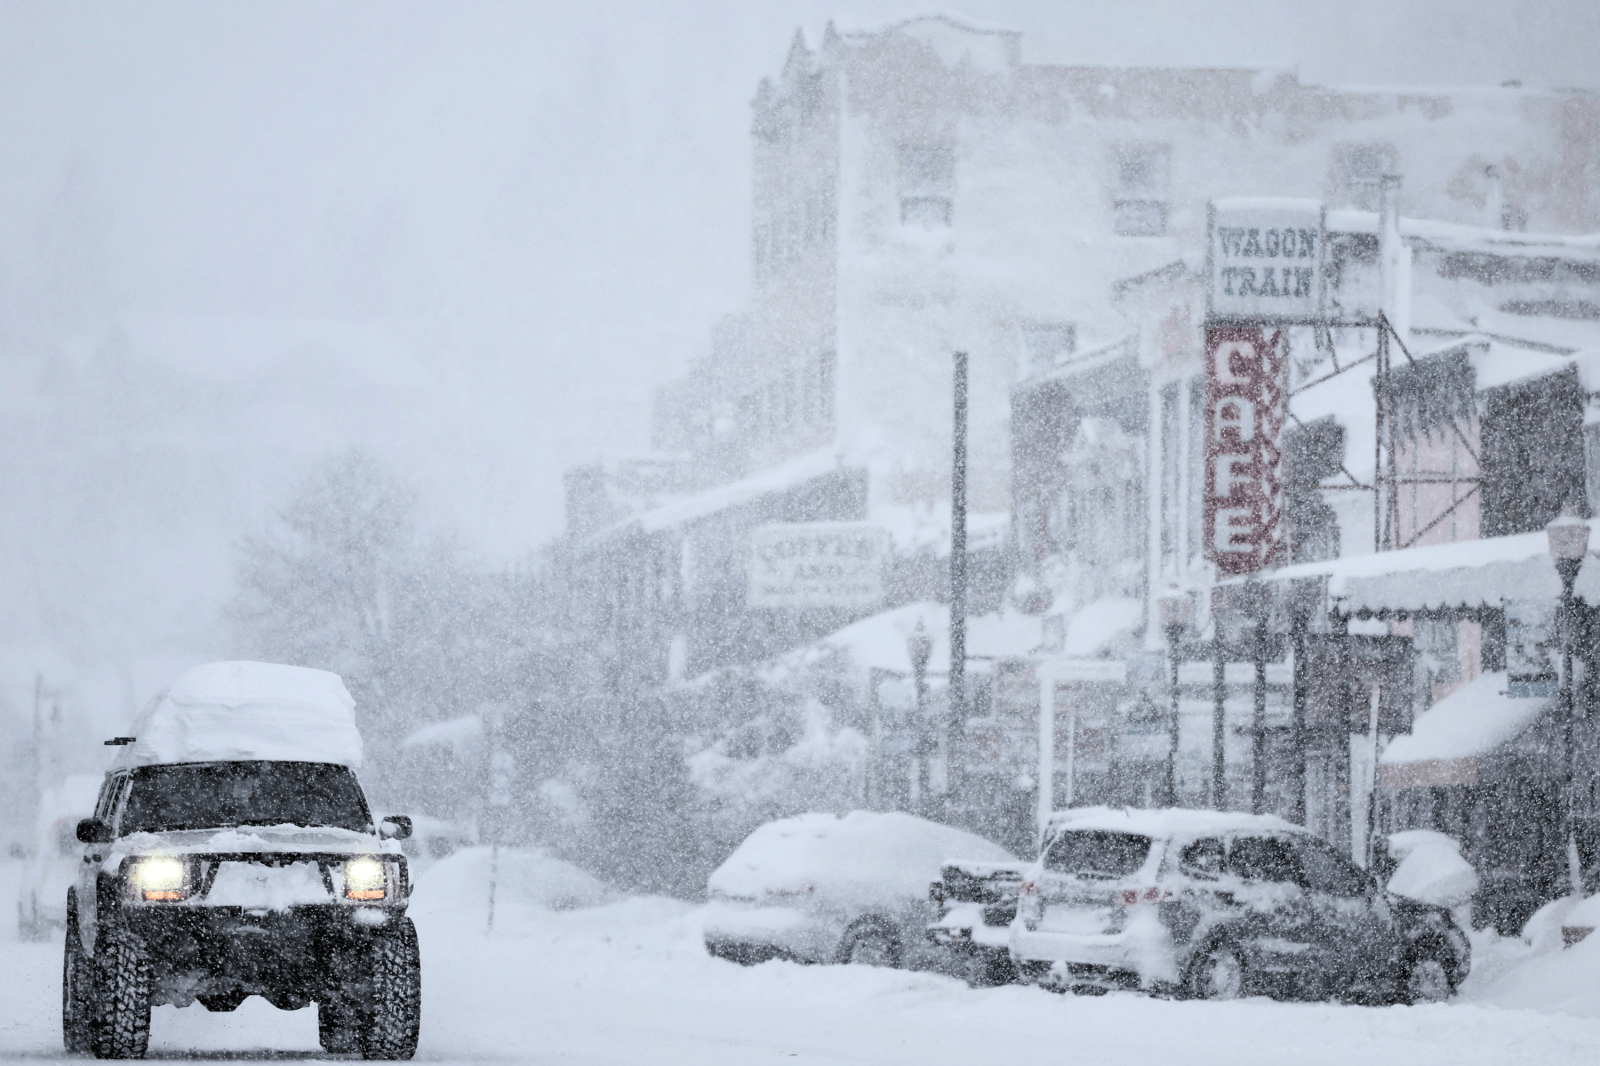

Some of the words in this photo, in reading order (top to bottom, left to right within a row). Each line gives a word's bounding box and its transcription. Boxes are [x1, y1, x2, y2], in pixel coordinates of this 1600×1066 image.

[1218, 226, 1318, 258] WAGON
[1221, 266, 1314, 297] TRAIN
[1214, 341, 1256, 552] CAFE
